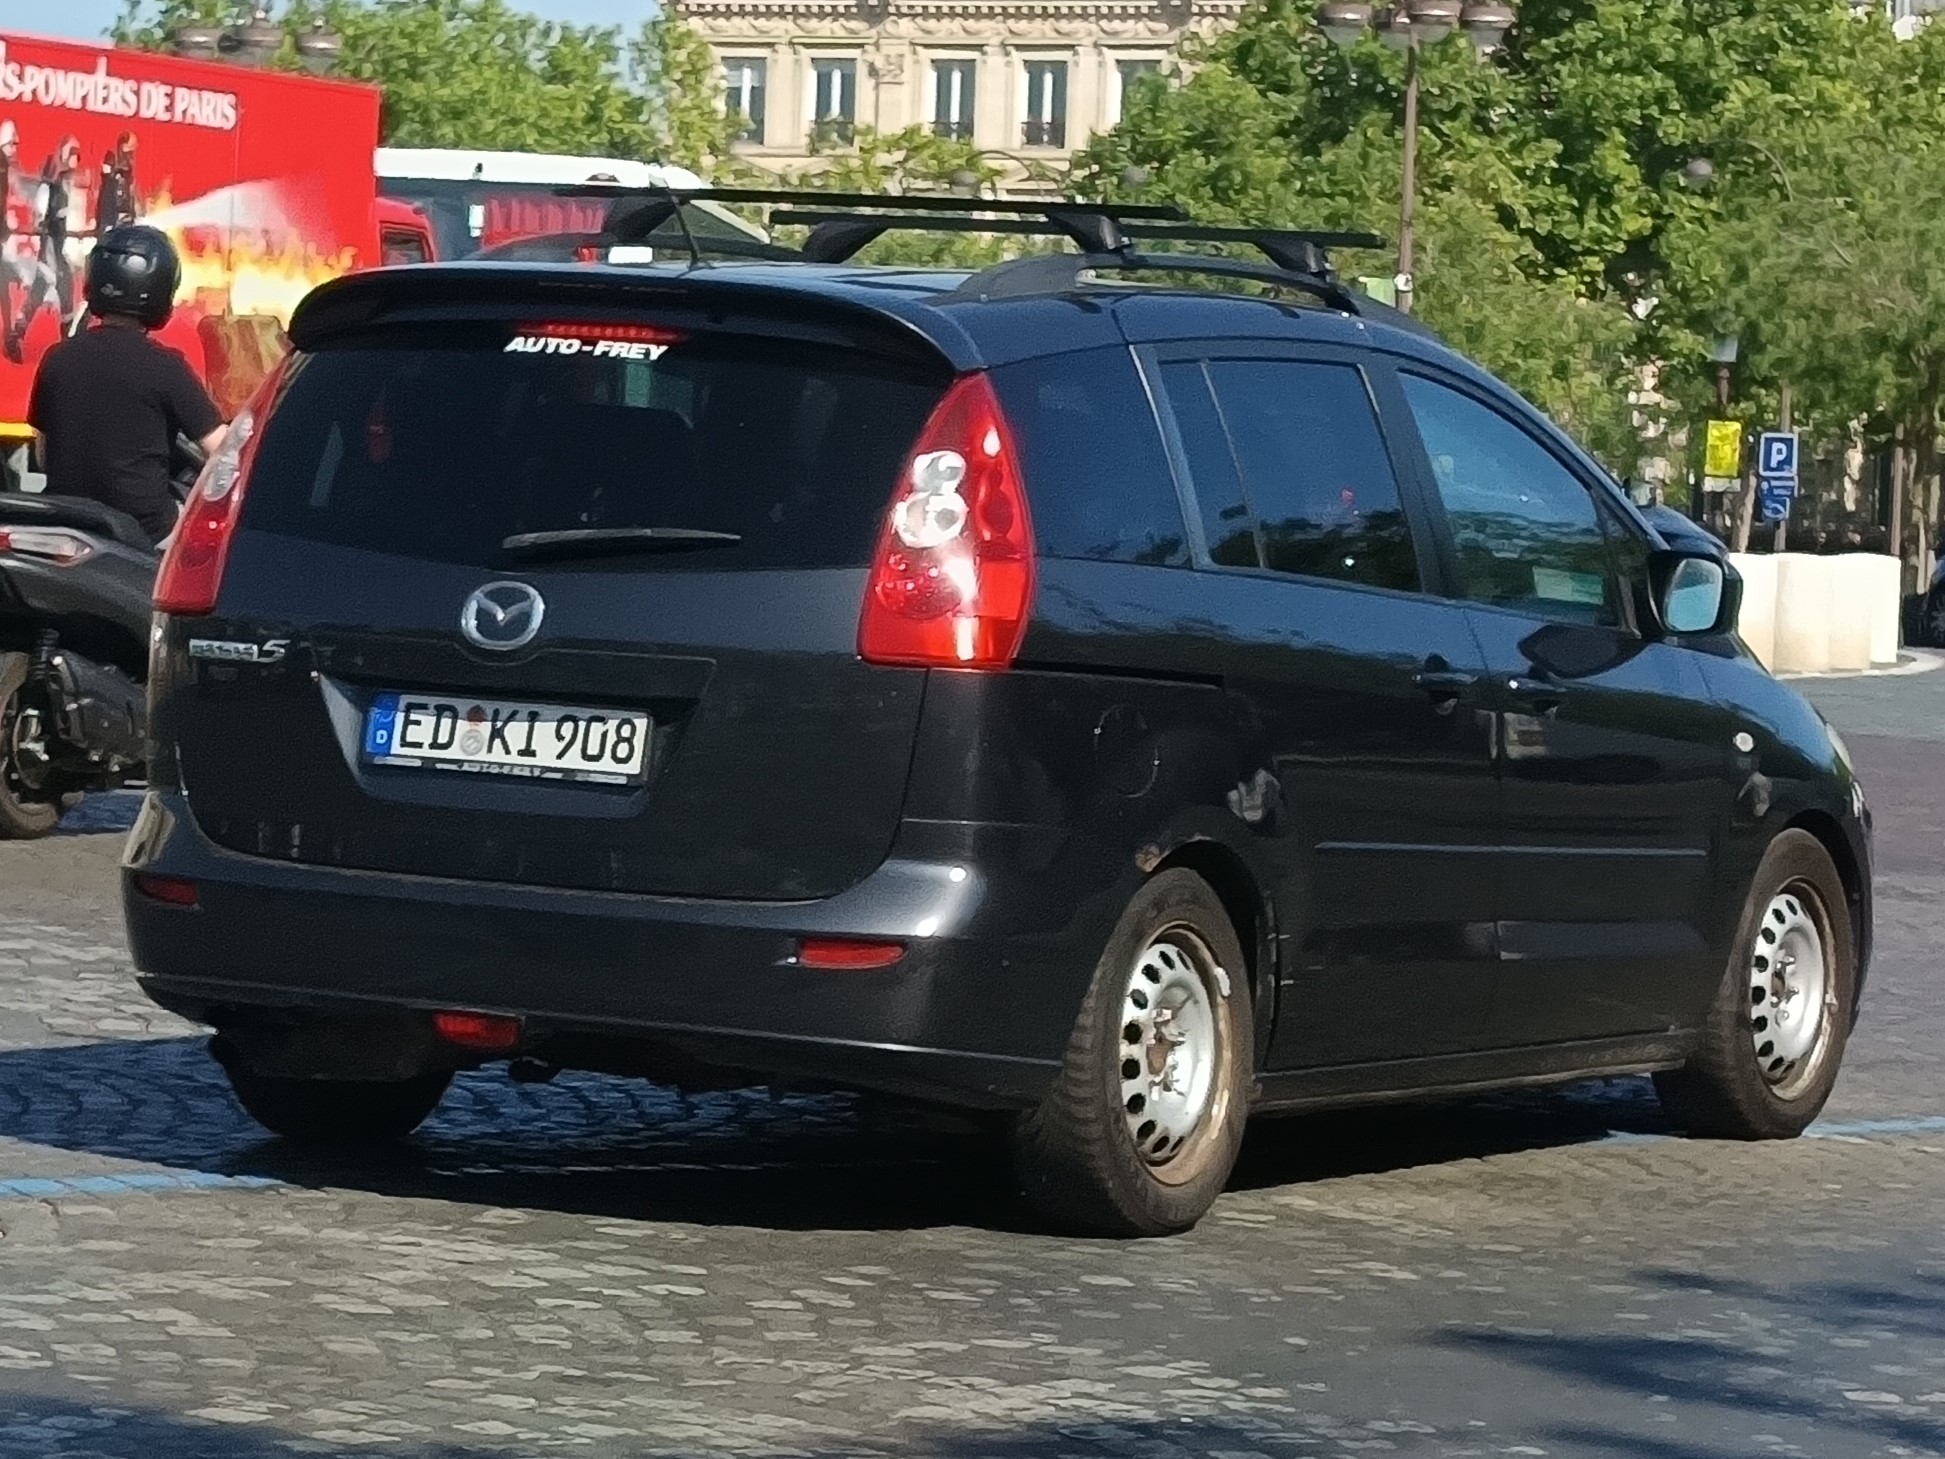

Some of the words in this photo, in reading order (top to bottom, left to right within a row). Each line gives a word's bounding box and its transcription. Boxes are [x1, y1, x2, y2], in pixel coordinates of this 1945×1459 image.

[0, 56, 139, 117] S-POMPIERS
[140, 81, 172, 122] DE
[173, 87, 238, 130] PARIS
[503, 336, 669, 361] AUTO-FREY
[1770, 442, 1787, 468] P
[374, 724, 388, 744] D
[399, 702, 459, 750] ED
[487, 708, 539, 758] KI
[555, 714, 637, 764] 908
